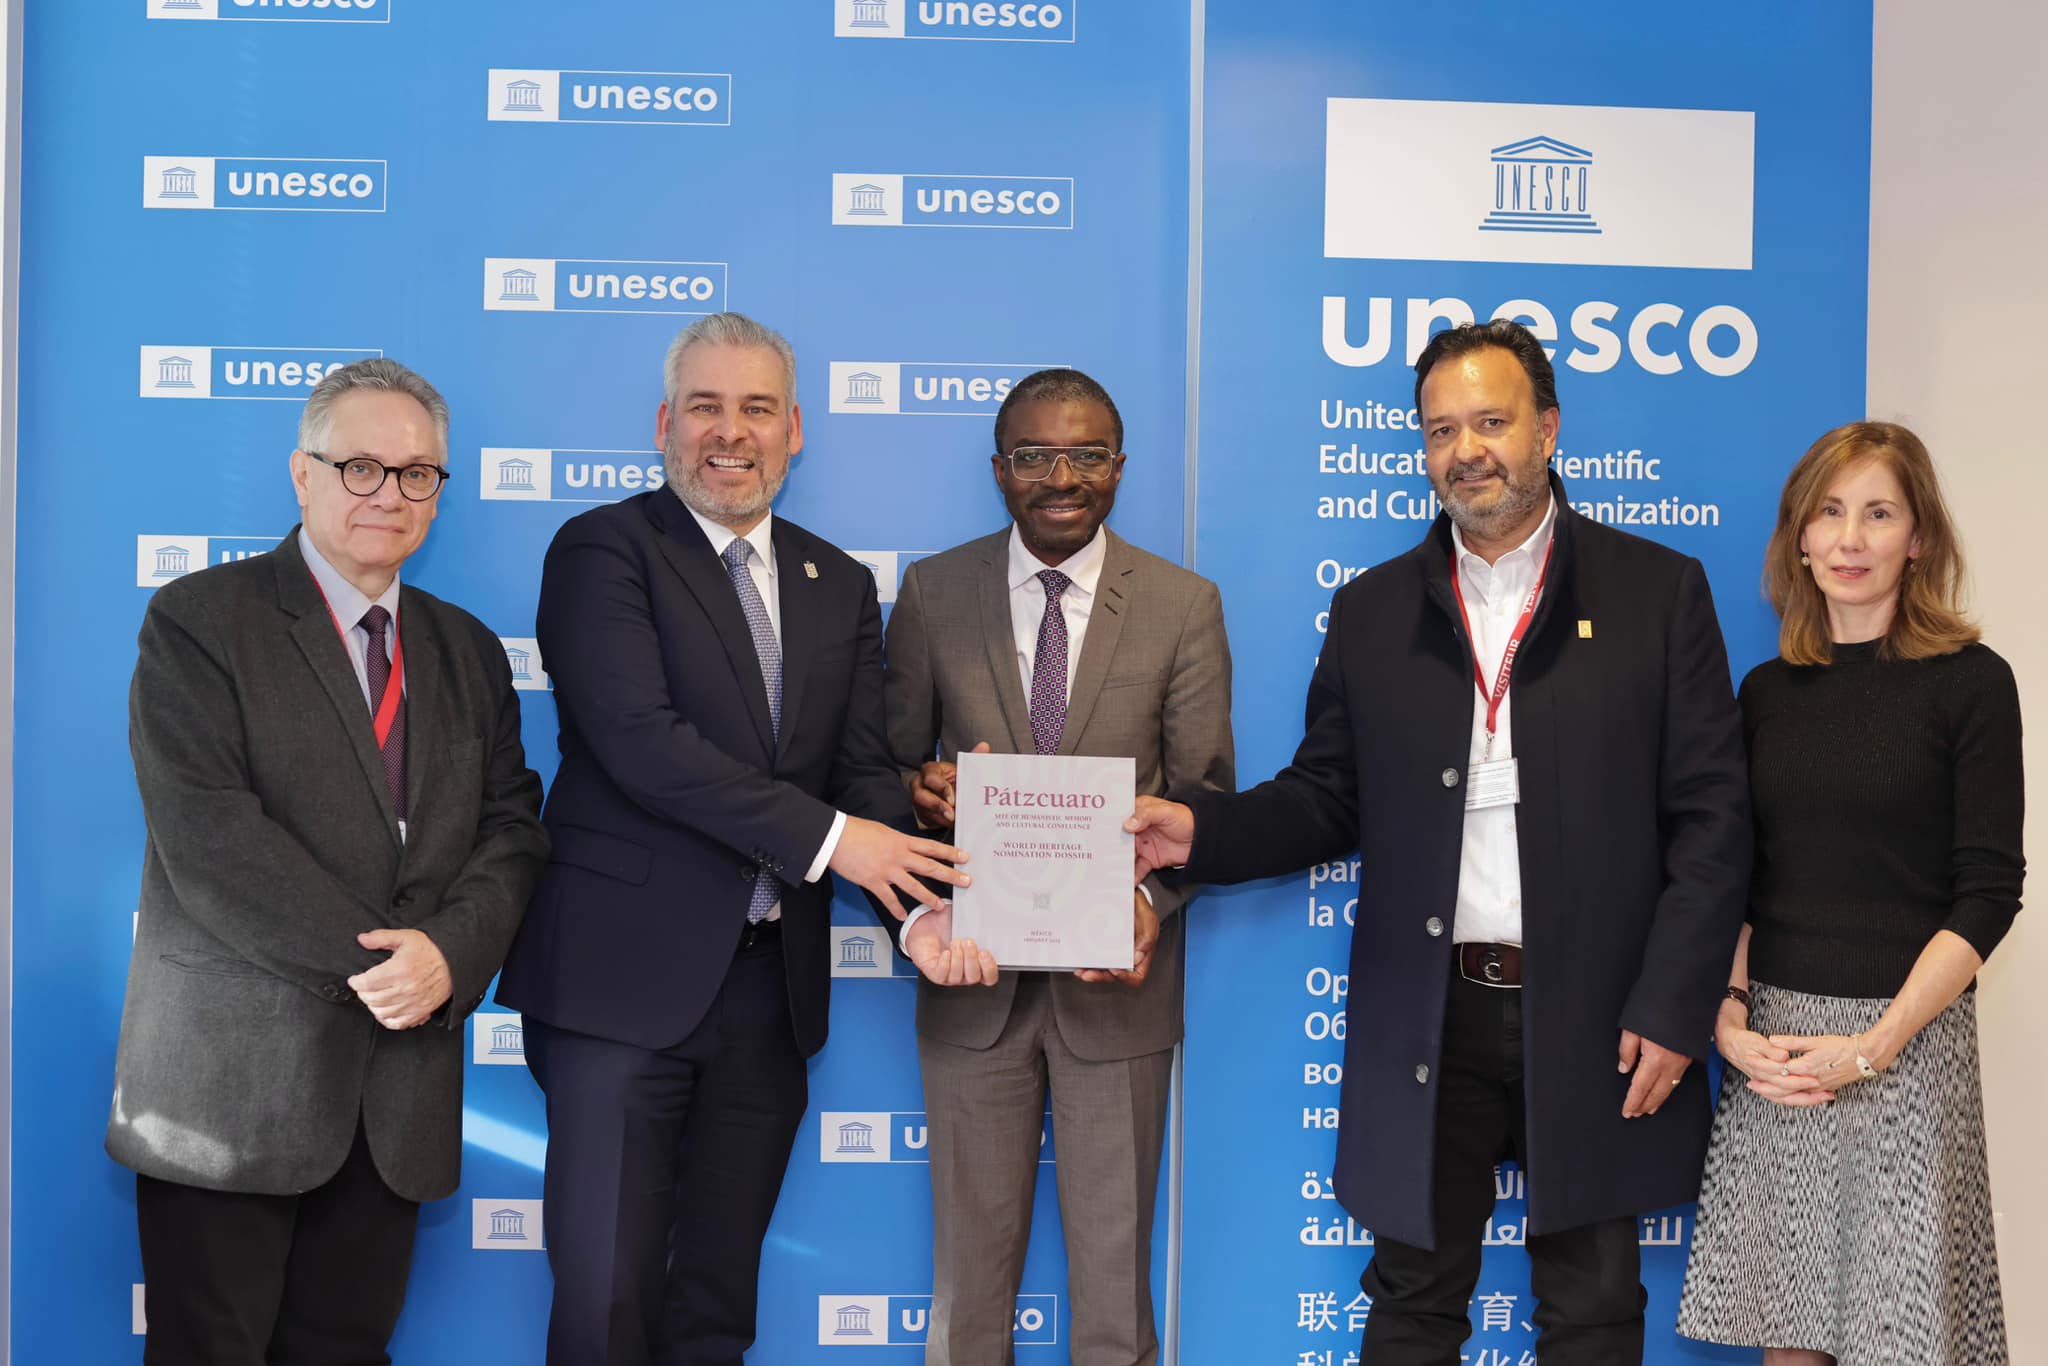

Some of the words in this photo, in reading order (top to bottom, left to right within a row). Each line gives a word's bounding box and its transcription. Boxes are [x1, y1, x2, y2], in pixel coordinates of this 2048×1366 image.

[920, 1, 1062, 28] unesco
[573, 86, 718, 112] unesco
[229, 172, 373, 198] unesco
[1496, 164, 1587, 212] UNESCO
[918, 190, 1060, 214] unesco
[570, 275, 714, 300] unesco
[226, 362, 345, 387] unes
[914, 377, 1023, 402] unes
[566, 464, 664, 490] unes
[1317, 490, 1377, 519] and
[984, 785, 1106, 809] Pátzcuaro
[993, 849, 1052, 859] NOMINATION
[1054, 851, 1093, 860] DOSSIER
[1003, 841, 1036, 850] WORLD
[1039, 842, 1083, 851] HERITAGE
[1308, 897, 1334, 927] la
